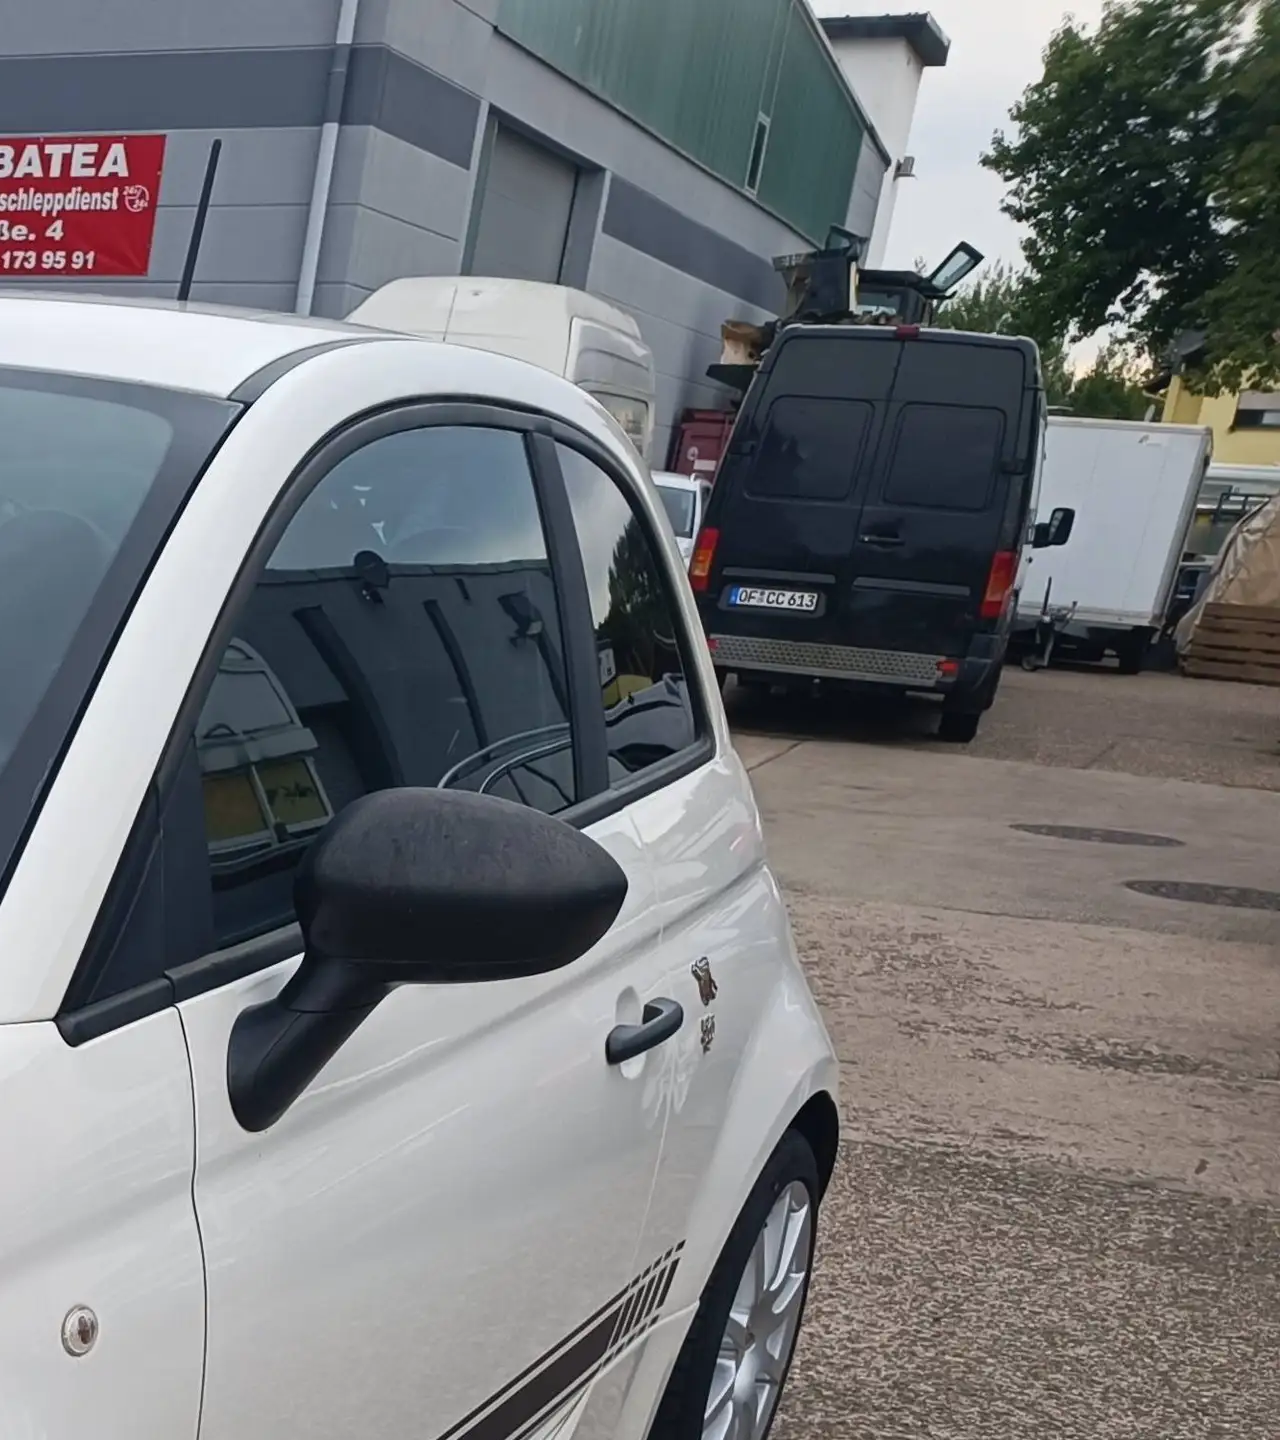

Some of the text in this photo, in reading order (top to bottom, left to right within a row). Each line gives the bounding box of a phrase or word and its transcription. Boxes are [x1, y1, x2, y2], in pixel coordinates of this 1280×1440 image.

[45, 219, 64, 241] 4
[1, 250, 37, 269] 173
[42, 250, 66, 269] 95
[71, 250, 96, 269] 91
[766, 591, 786, 606] CC
[788, 593, 816, 608] 613
